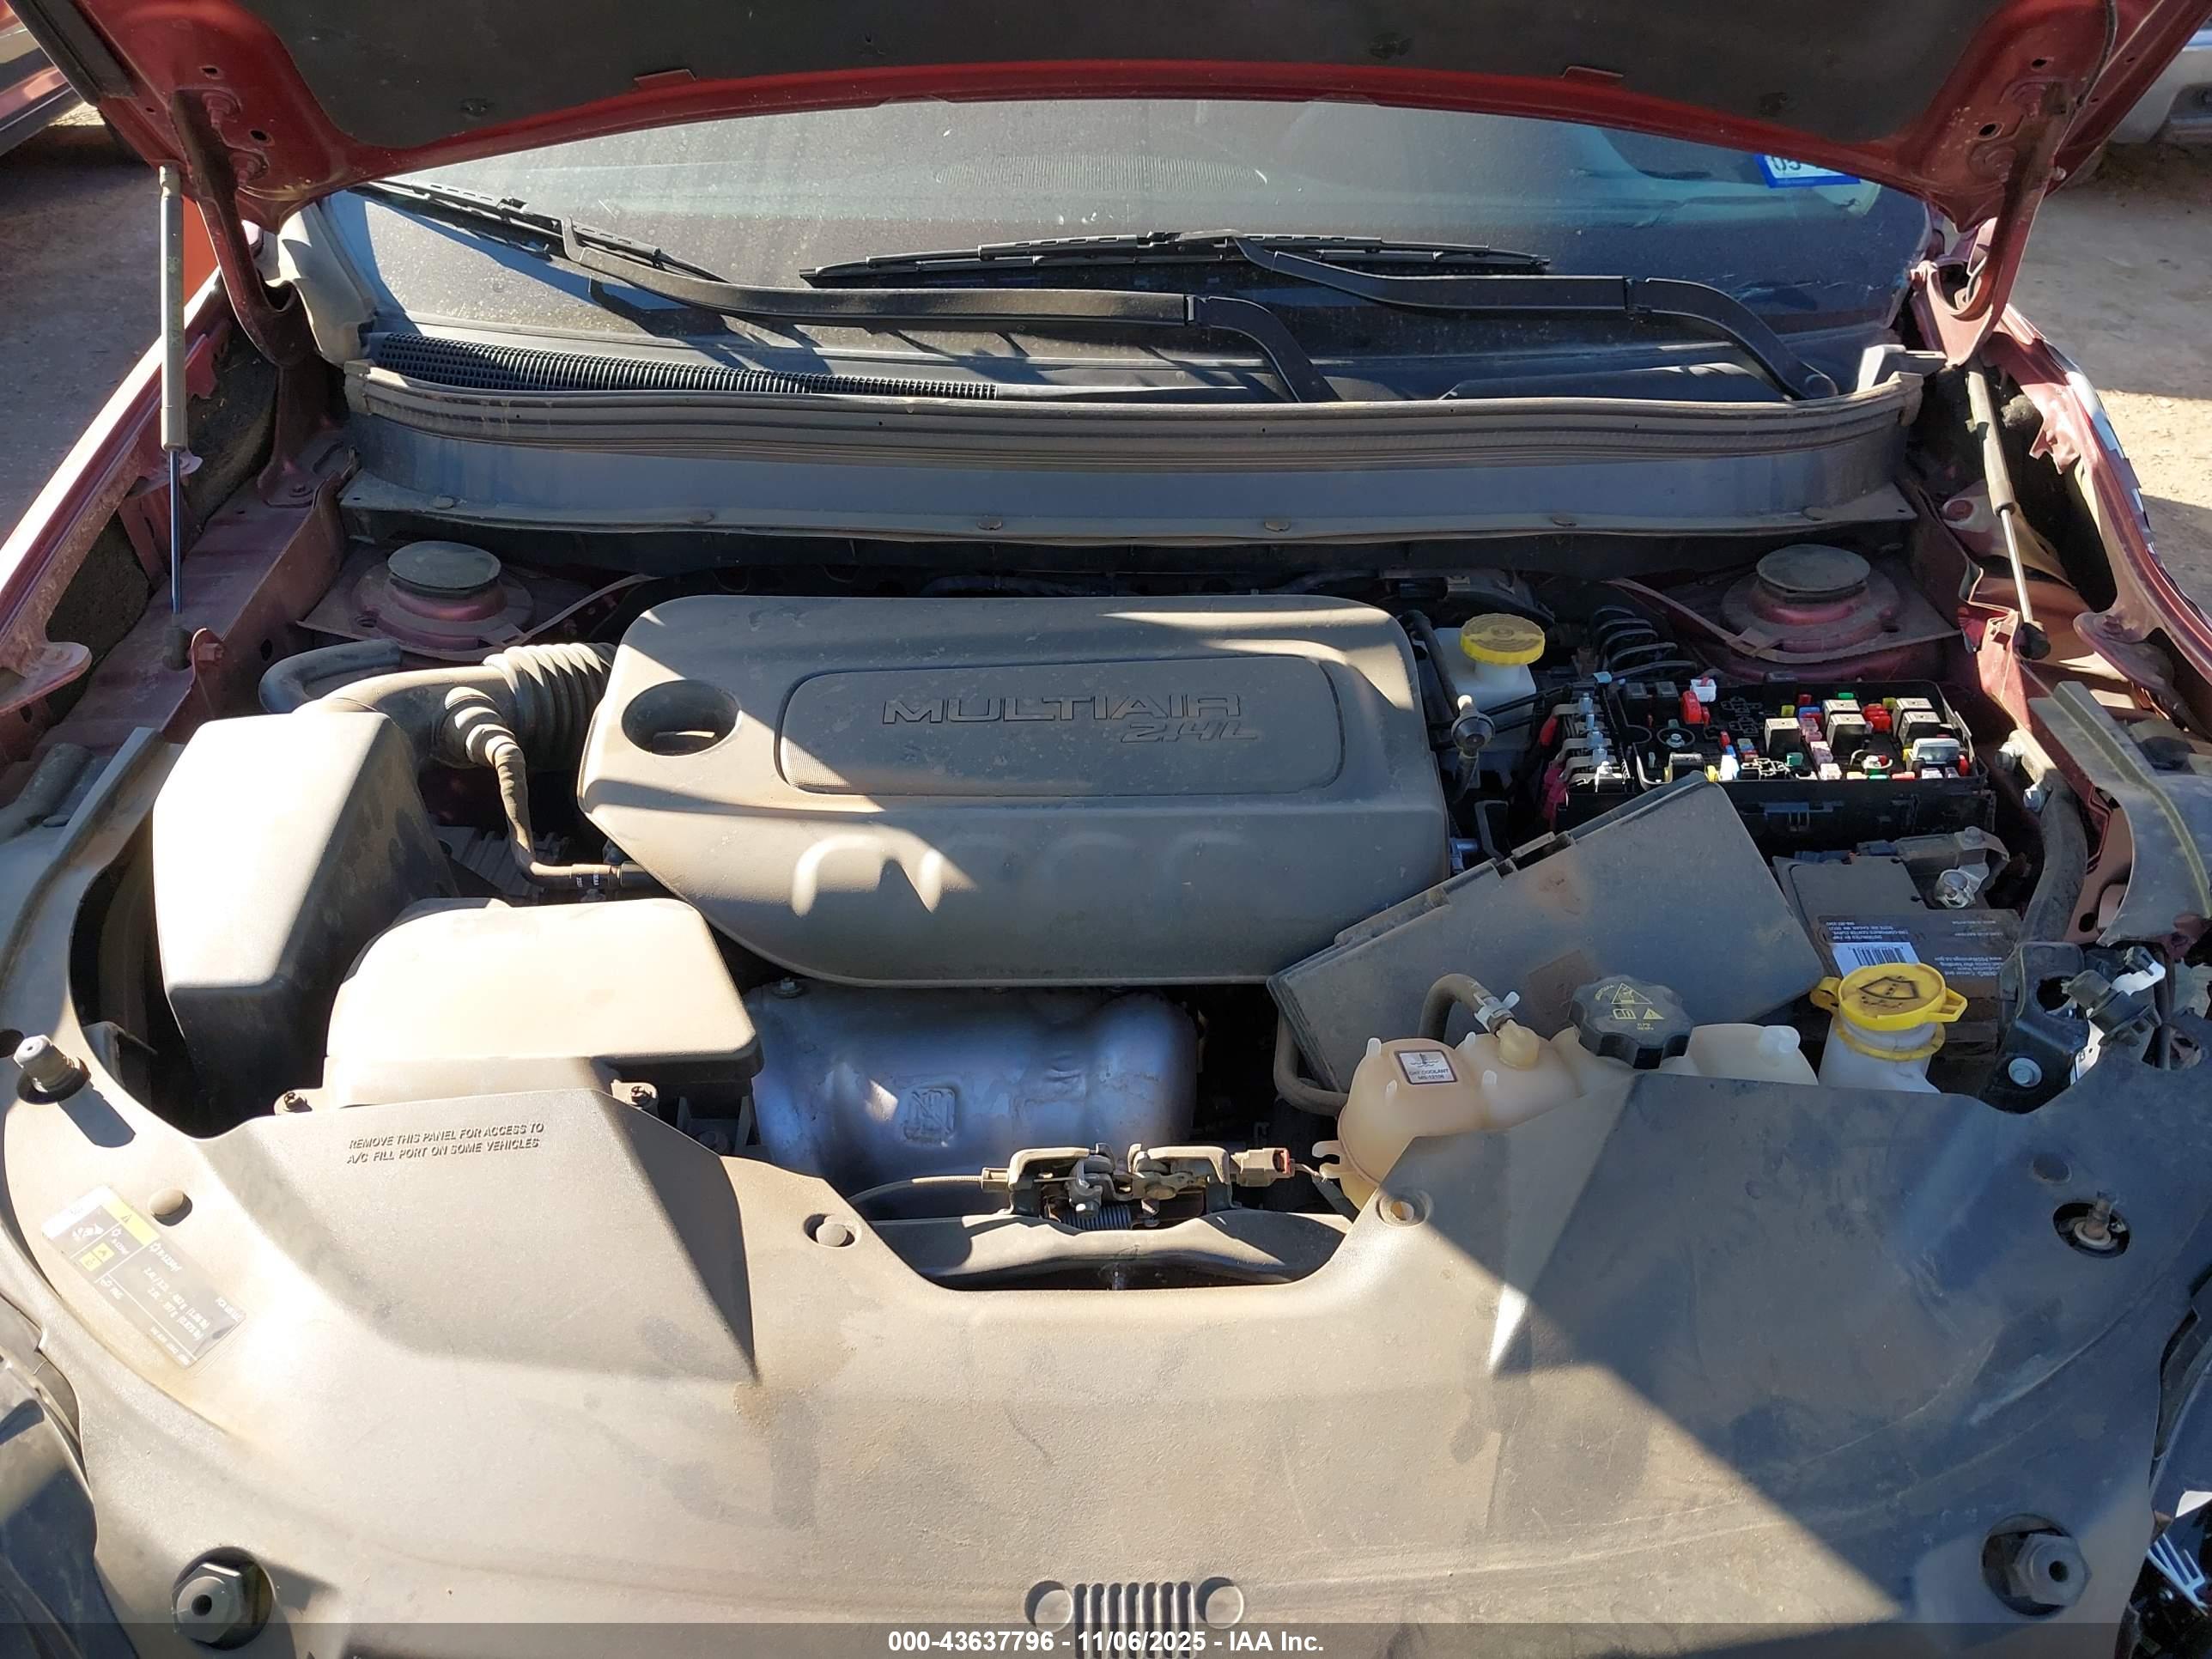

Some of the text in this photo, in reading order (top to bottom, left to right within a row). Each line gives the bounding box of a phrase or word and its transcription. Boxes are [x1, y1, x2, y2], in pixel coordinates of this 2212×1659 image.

[883, 694, 1241, 724] MULTIAIR
[1120, 720, 1258, 744] 2.4L
[349, 1122, 544, 1149] REMOVE THIS PANEL FOR ACCESS TO
[347, 1138, 540, 1164] A/C FILL PORT ON SOME VEHICLES
